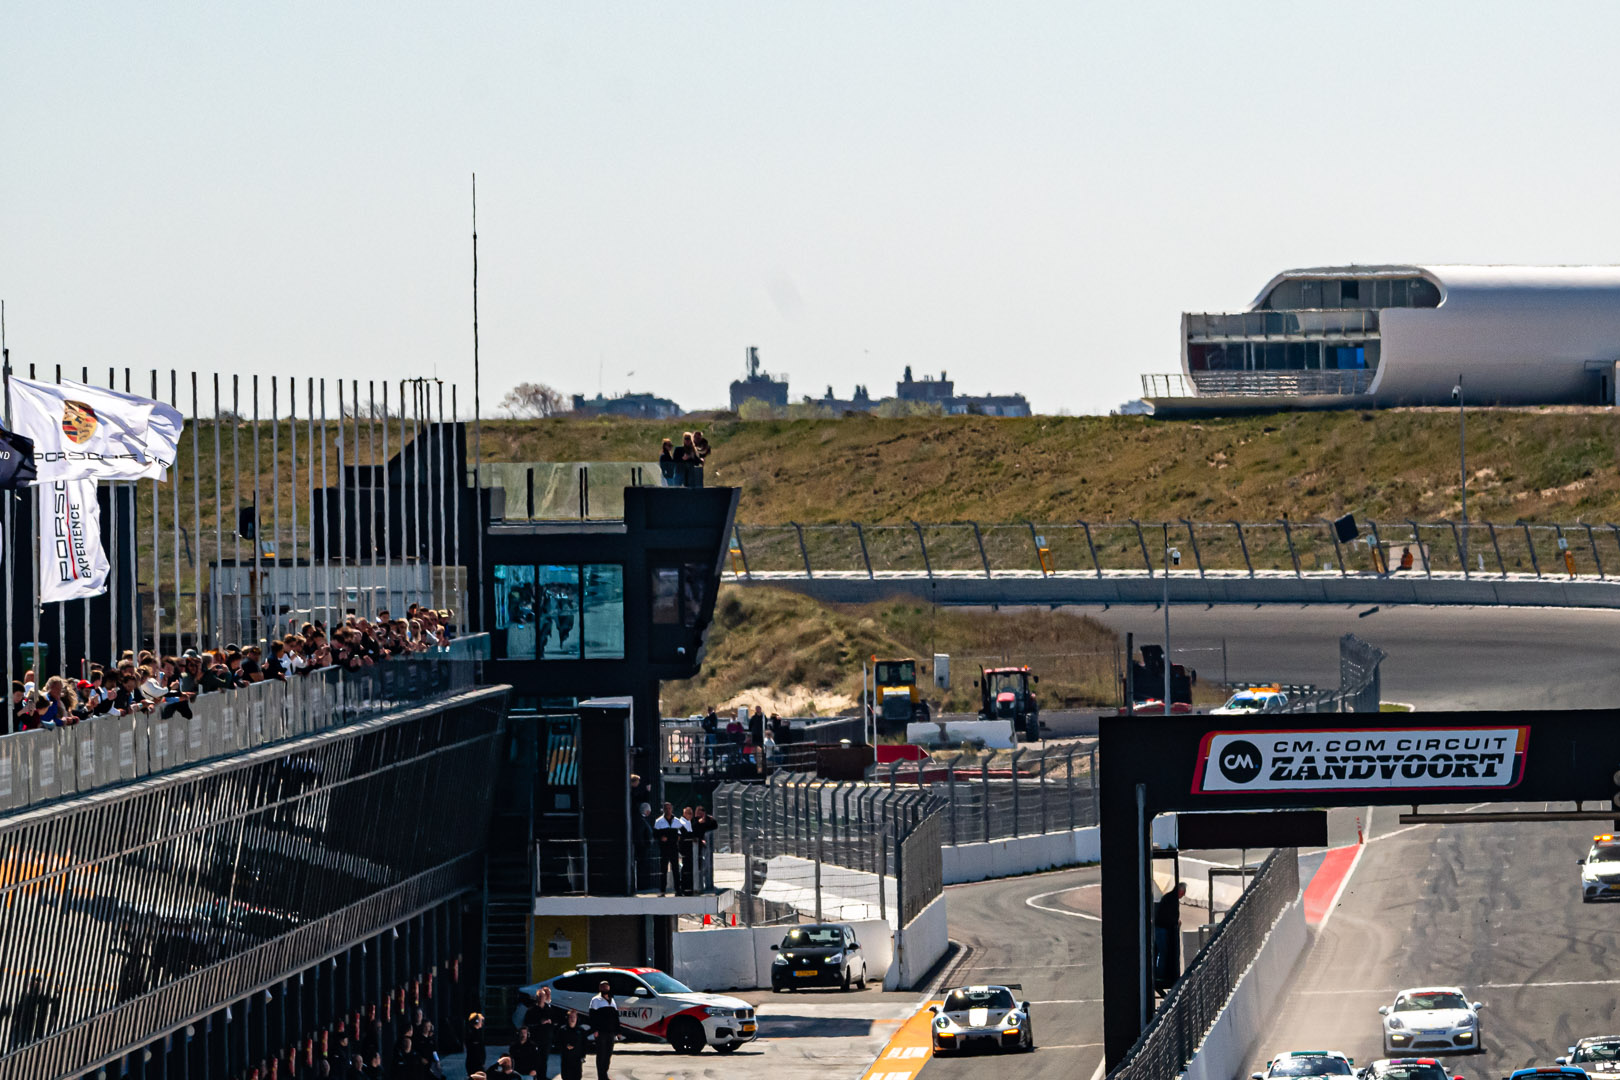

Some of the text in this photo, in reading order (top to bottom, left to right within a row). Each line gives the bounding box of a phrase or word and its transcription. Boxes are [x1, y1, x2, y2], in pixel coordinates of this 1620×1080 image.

[70, 503, 92, 579] EXPERIENCE
[1273, 737, 1507, 753] CM.COM CIRCUIT
[1269, 752, 1505, 781] ZANDVOORT
